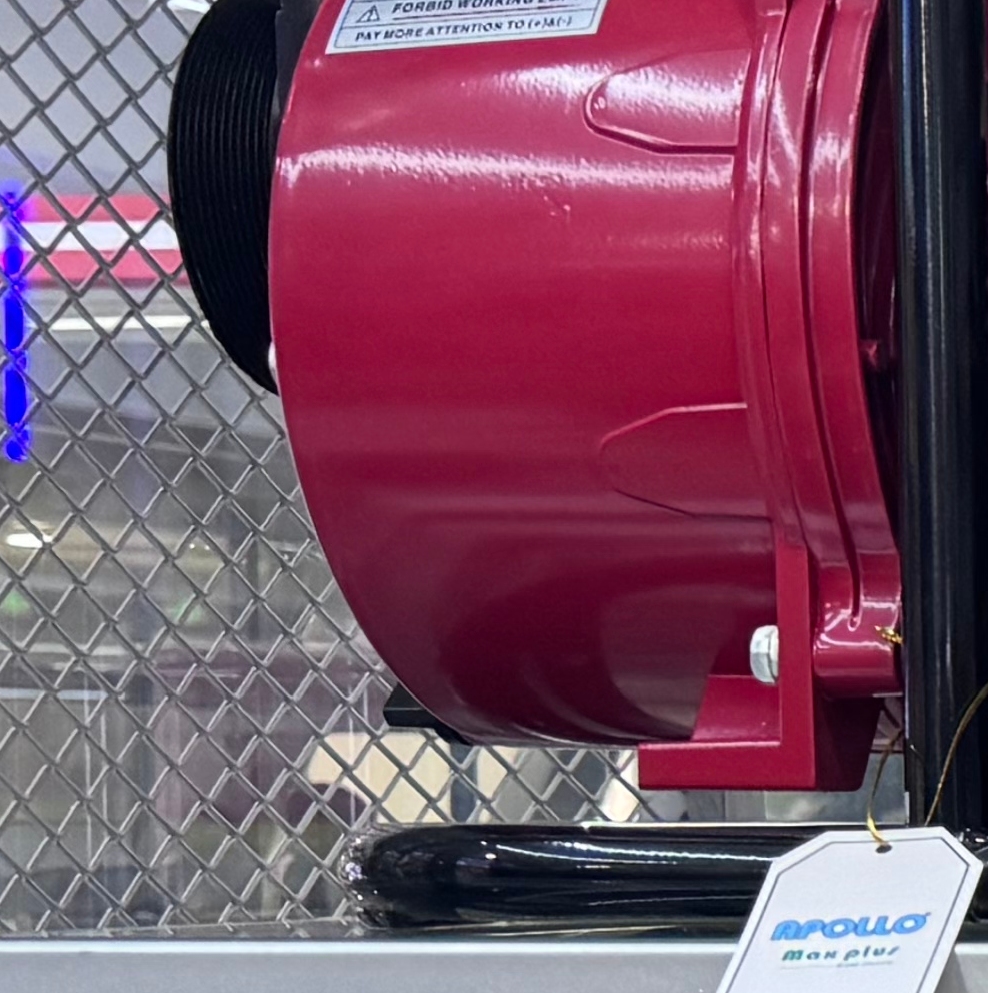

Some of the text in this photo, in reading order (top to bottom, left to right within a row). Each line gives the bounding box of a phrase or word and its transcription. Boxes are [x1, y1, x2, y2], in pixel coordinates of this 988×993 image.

[392, 0, 453, 14] FORBID
[355, 30, 381, 42] PAY
[383, 25, 423, 40] MORE
[425, 20, 504, 37] ATTENTION
[507, 19, 525, 29] TO
[781, 945, 900, 961] Max plus
